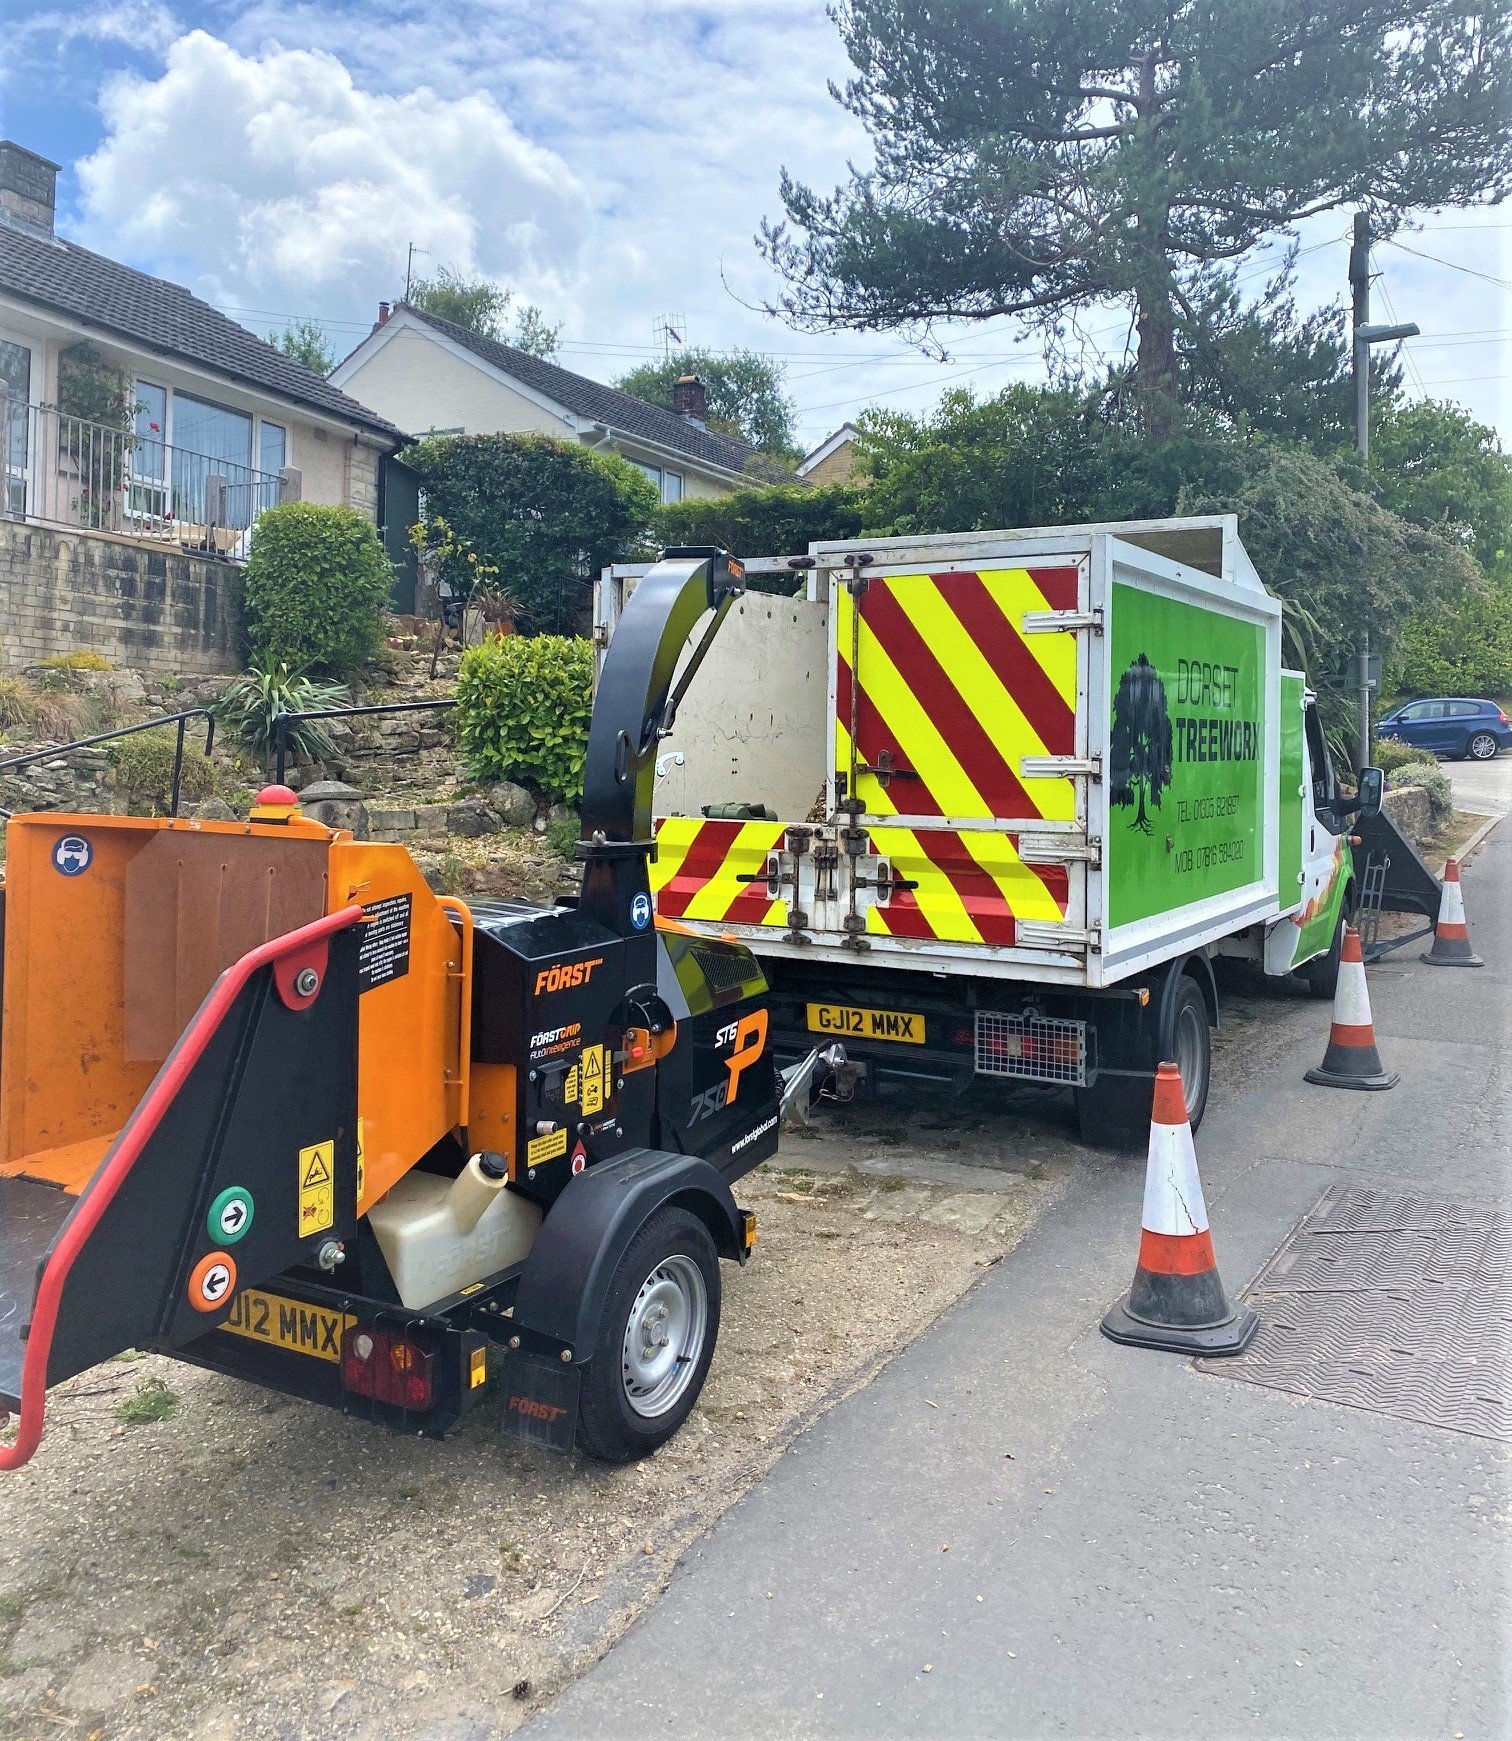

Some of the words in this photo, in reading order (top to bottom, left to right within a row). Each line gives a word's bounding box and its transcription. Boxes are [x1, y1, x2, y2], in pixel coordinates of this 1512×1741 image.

[1178, 659, 1238, 708] DORSET
[1176, 718, 1260, 762] TREEWORX
[534, 958, 603, 996] FÖRST
[714, 1021, 739, 1049] ST6
[819, 1008, 864, 1032] GJ12
[871, 1013, 914, 1038] MMX
[229, 1292, 270, 1336] J12
[279, 1304, 339, 1355] MMX
